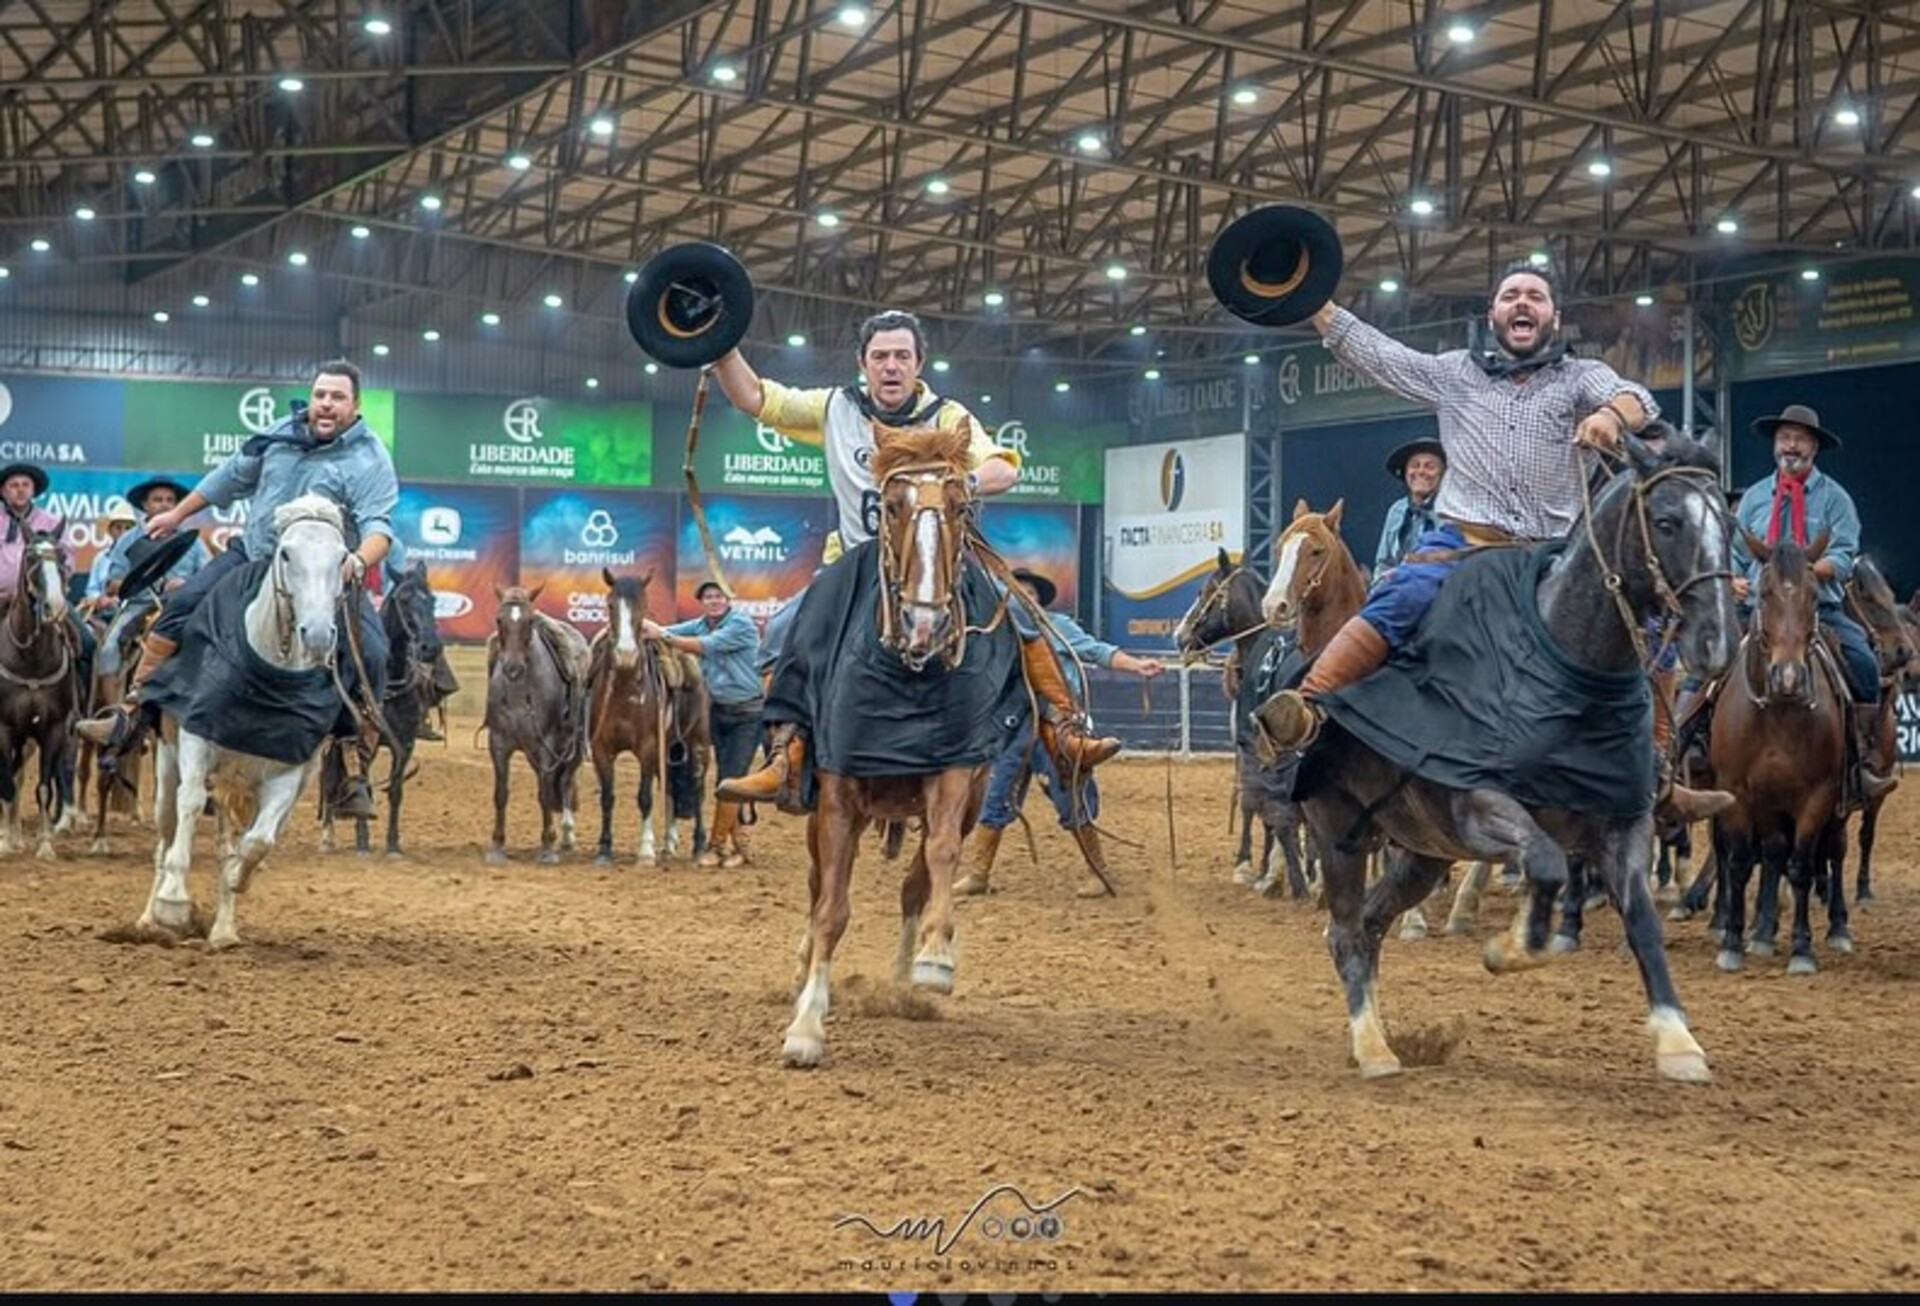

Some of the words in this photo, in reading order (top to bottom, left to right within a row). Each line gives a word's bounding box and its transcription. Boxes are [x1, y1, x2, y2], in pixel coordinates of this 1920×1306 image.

[470, 443, 576, 465] LIBERDADE
[724, 453, 824, 475] LIBERDADE
[564, 547, 635, 566] banrisul
[719, 544, 787, 563] VETNIL
